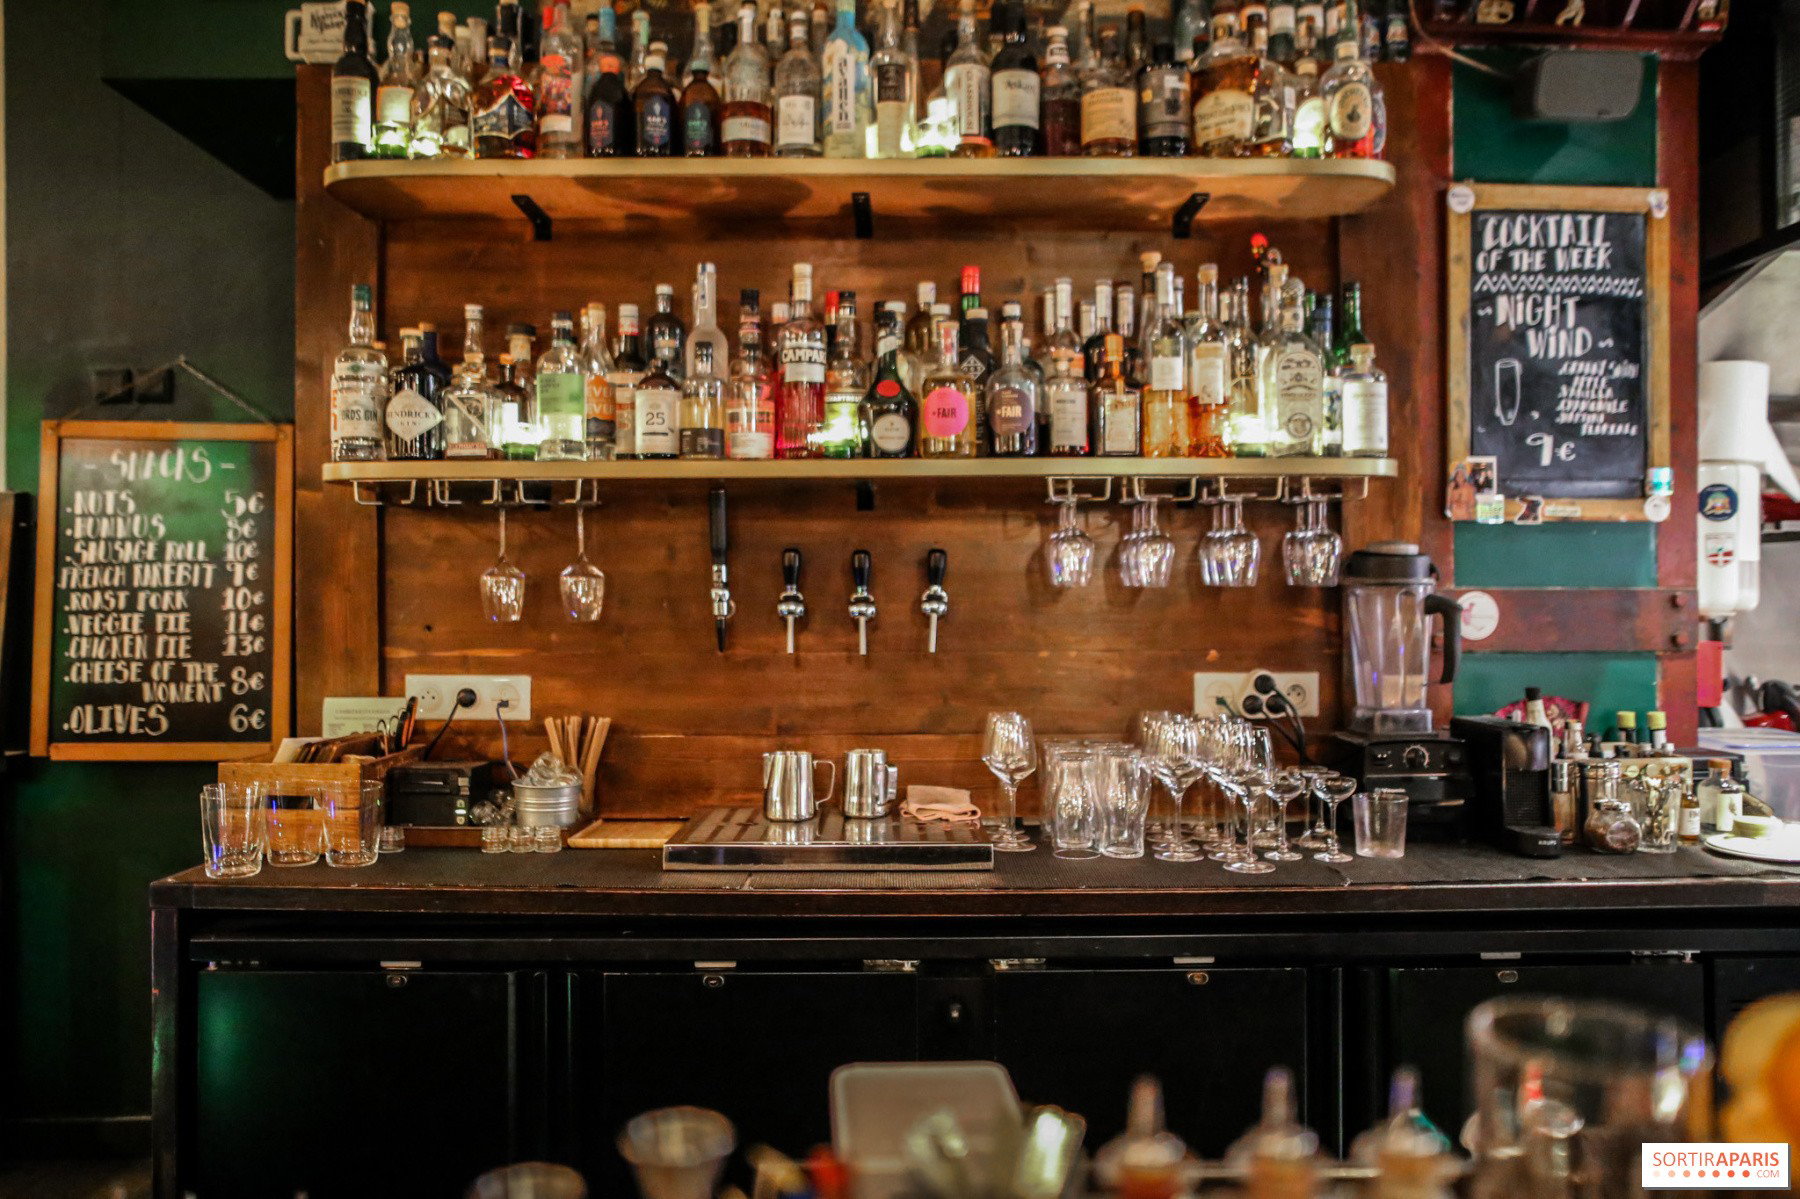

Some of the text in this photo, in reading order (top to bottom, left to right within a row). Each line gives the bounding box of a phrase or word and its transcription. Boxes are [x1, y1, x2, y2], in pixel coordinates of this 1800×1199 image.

[1480, 213, 1611, 250] COCKTAIL
[1475, 247, 1612, 273] OF THE WEEK
[645, 411, 666, 426] 25
[1525, 432, 1576, 466] 9€
[221, 488, 265, 517] 5€
[165, 540, 209, 563] ROLL
[224, 540, 259, 562] 10€
[136, 590, 190, 612] PORK
[221, 587, 265, 611] 10€
[155, 612, 191, 634] PIE
[225, 611, 265, 634] 11€
[155, 634, 192, 660] PIE
[221, 634, 265, 656] 13€
[150, 660, 175, 682] OF
[182, 662, 219, 683] THE
[230, 665, 265, 695] 8€
[142, 682, 226, 704] MOMENT
[229, 703, 266, 733] 6€
